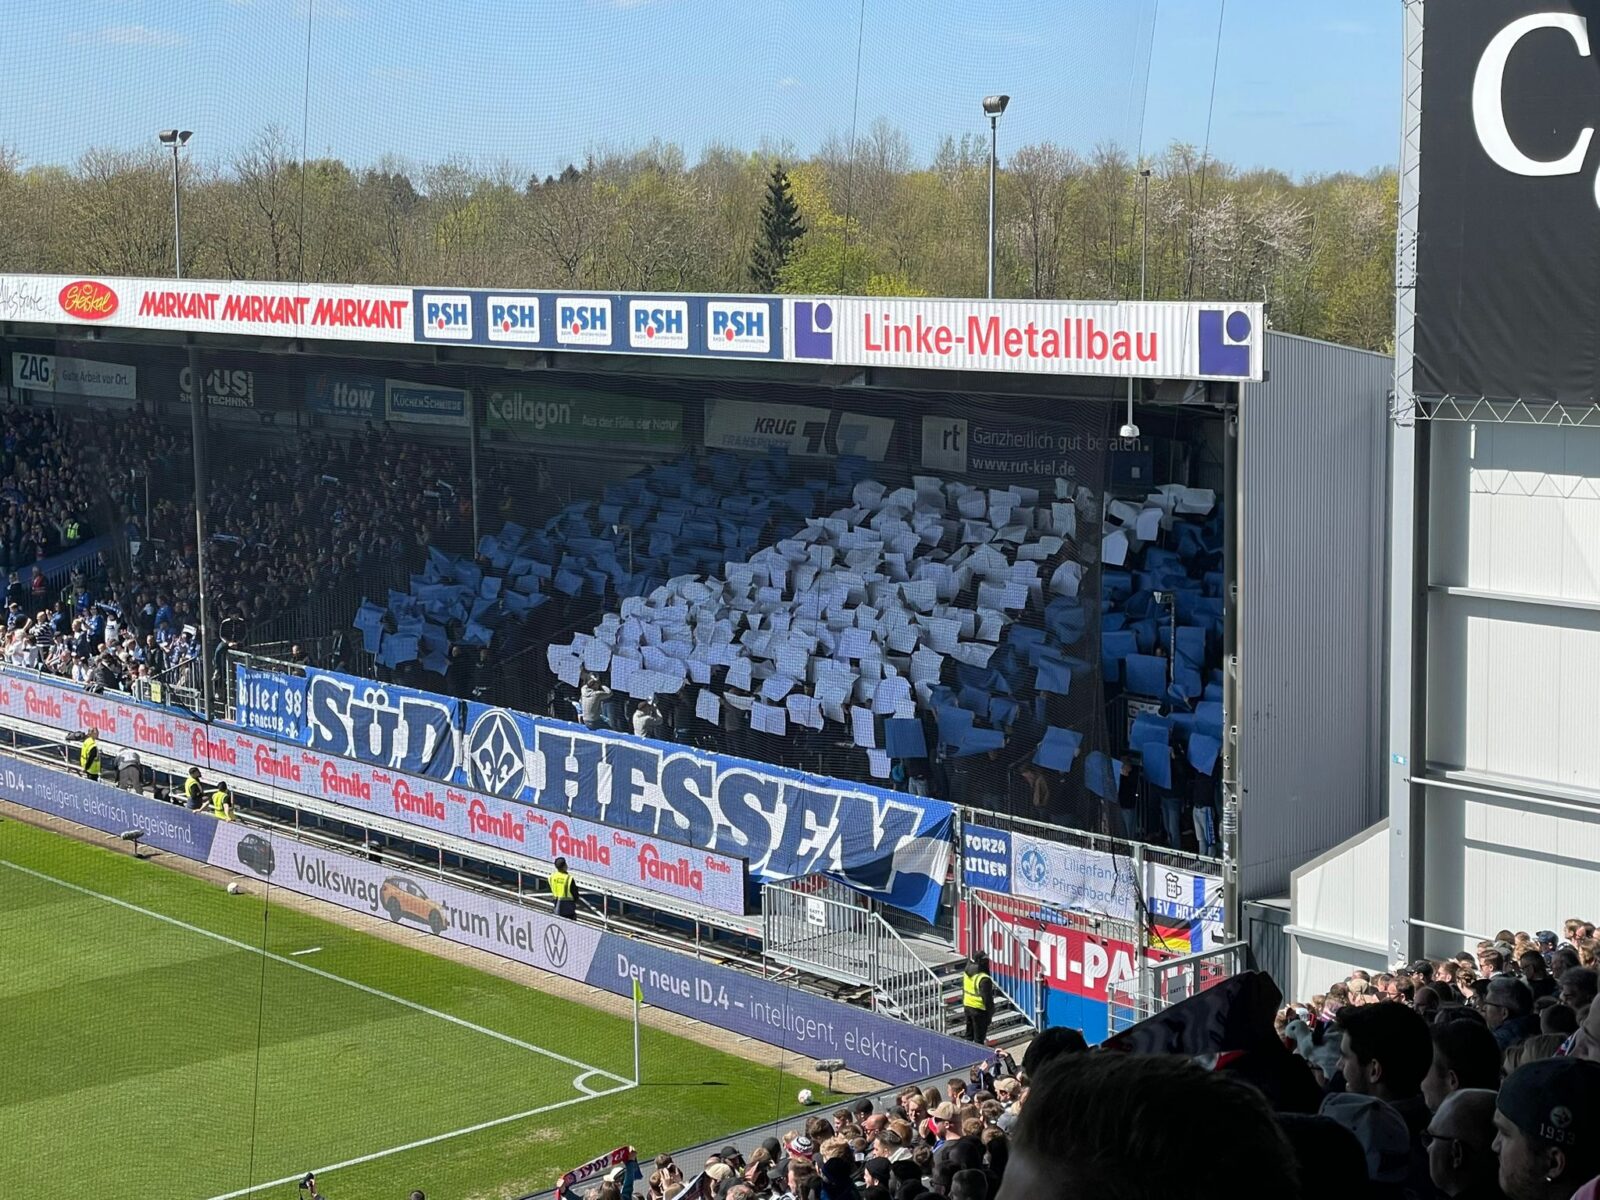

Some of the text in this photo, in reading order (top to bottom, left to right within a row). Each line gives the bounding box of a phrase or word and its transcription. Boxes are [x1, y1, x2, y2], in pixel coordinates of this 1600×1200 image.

[138, 291, 409, 329] MARKANT MARKANT MARKANT
[427, 302, 468, 326] RSH
[492, 304, 535, 328] RSH
[561, 306, 607, 331] RSH
[634, 309, 683, 334] RSH
[713, 310, 764, 337] RSH
[864, 312, 1158, 362] Linke-Metallbau
[20, 354, 50, 383] ZAG
[754, 417, 797, 436] KRUG
[943, 424, 960, 451] rt
[973, 427, 1053, 449] Ganzheitlich
[1058, 434, 1081, 454] gut
[972, 457, 1076, 477] www.rut-kiel.de
[77, 699, 116, 733] famila
[133, 713, 174, 748] famila
[192, 728, 236, 765] famila
[254, 744, 301, 782] famila
[321, 761, 371, 800] famila
[392, 779, 445, 821] famila
[467, 799, 525, 843] famila
[549, 820, 611, 867] famila
[637, 843, 703, 892] famila
[705, 855, 731, 874] famila
[306, 675, 924, 895] SÜD HESSEN
[5, 770, 25, 792] ID.4
[83, 795, 130, 829] elektrisch,
[132, 809, 195, 846] begeisternd.
[293, 853, 381, 911] Volkswag
[496, 912, 535, 953] Kiel
[617, 953, 646, 984] Der
[649, 966, 692, 998] neue
[695, 978, 731, 1011] ID.4
[749, 994, 840, 1052] intelligent,
